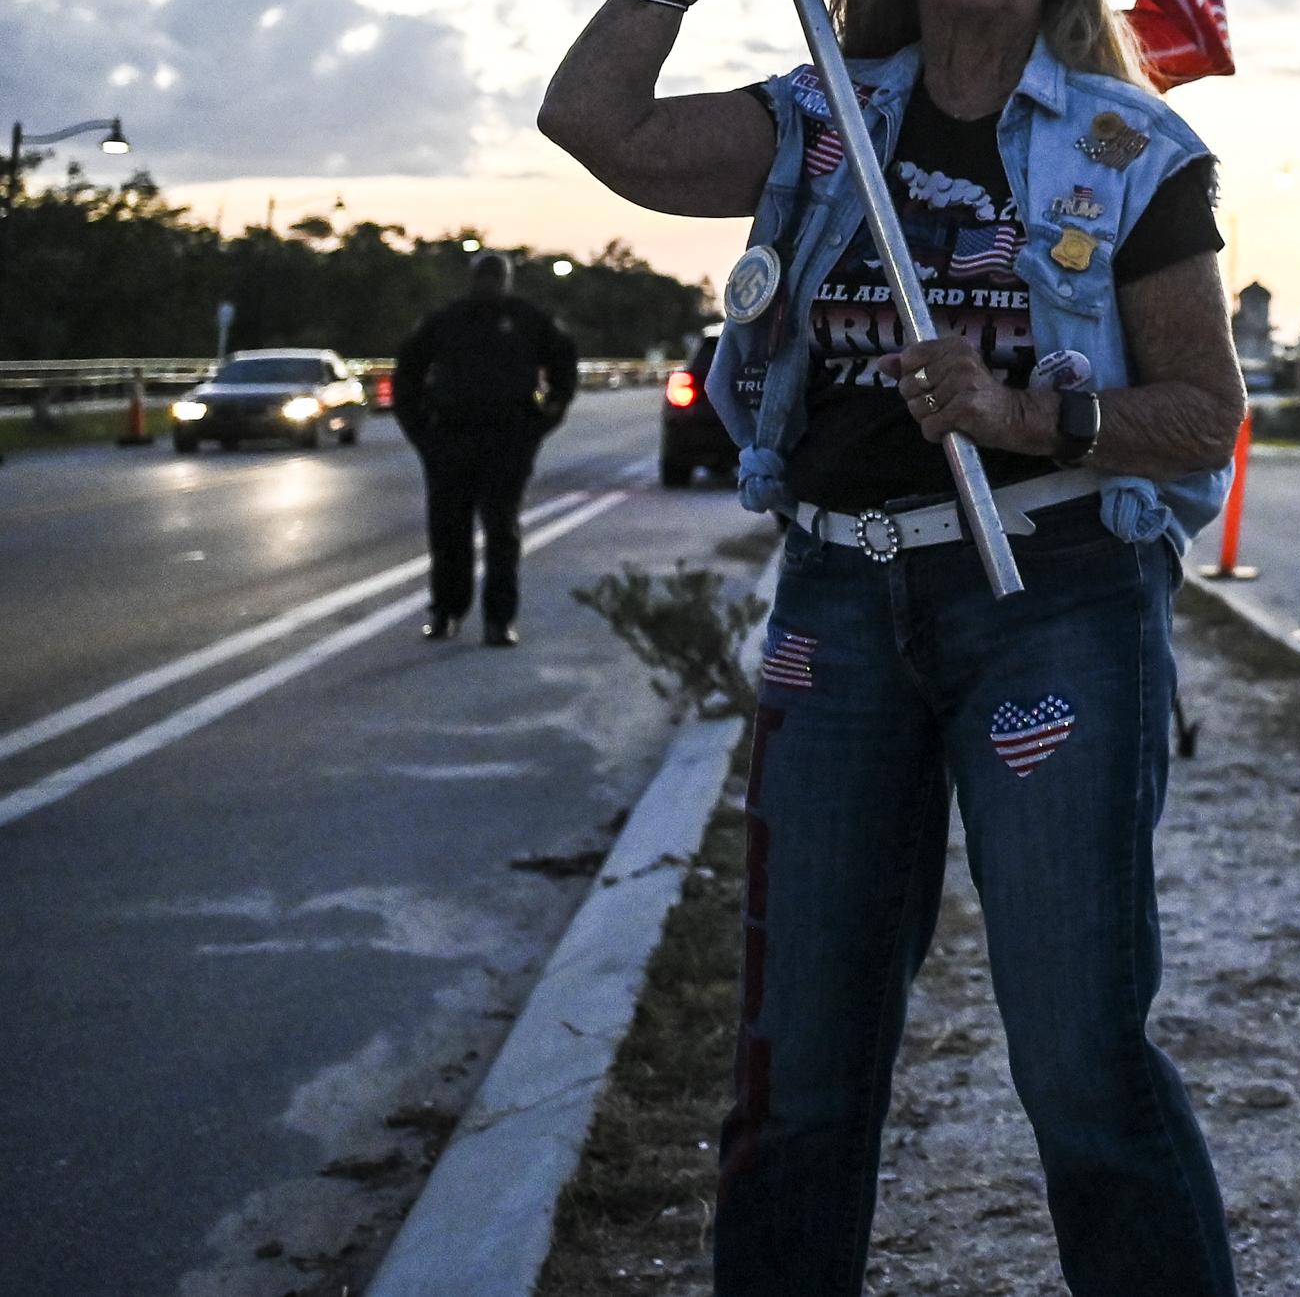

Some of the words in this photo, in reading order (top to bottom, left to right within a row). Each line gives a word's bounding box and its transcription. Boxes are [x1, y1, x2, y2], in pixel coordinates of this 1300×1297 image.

[813, 283, 848, 301] LL
[853, 284, 966, 306] ABRD
[971, 288, 1029, 309] THE
[735, 380, 764, 392] TRU
